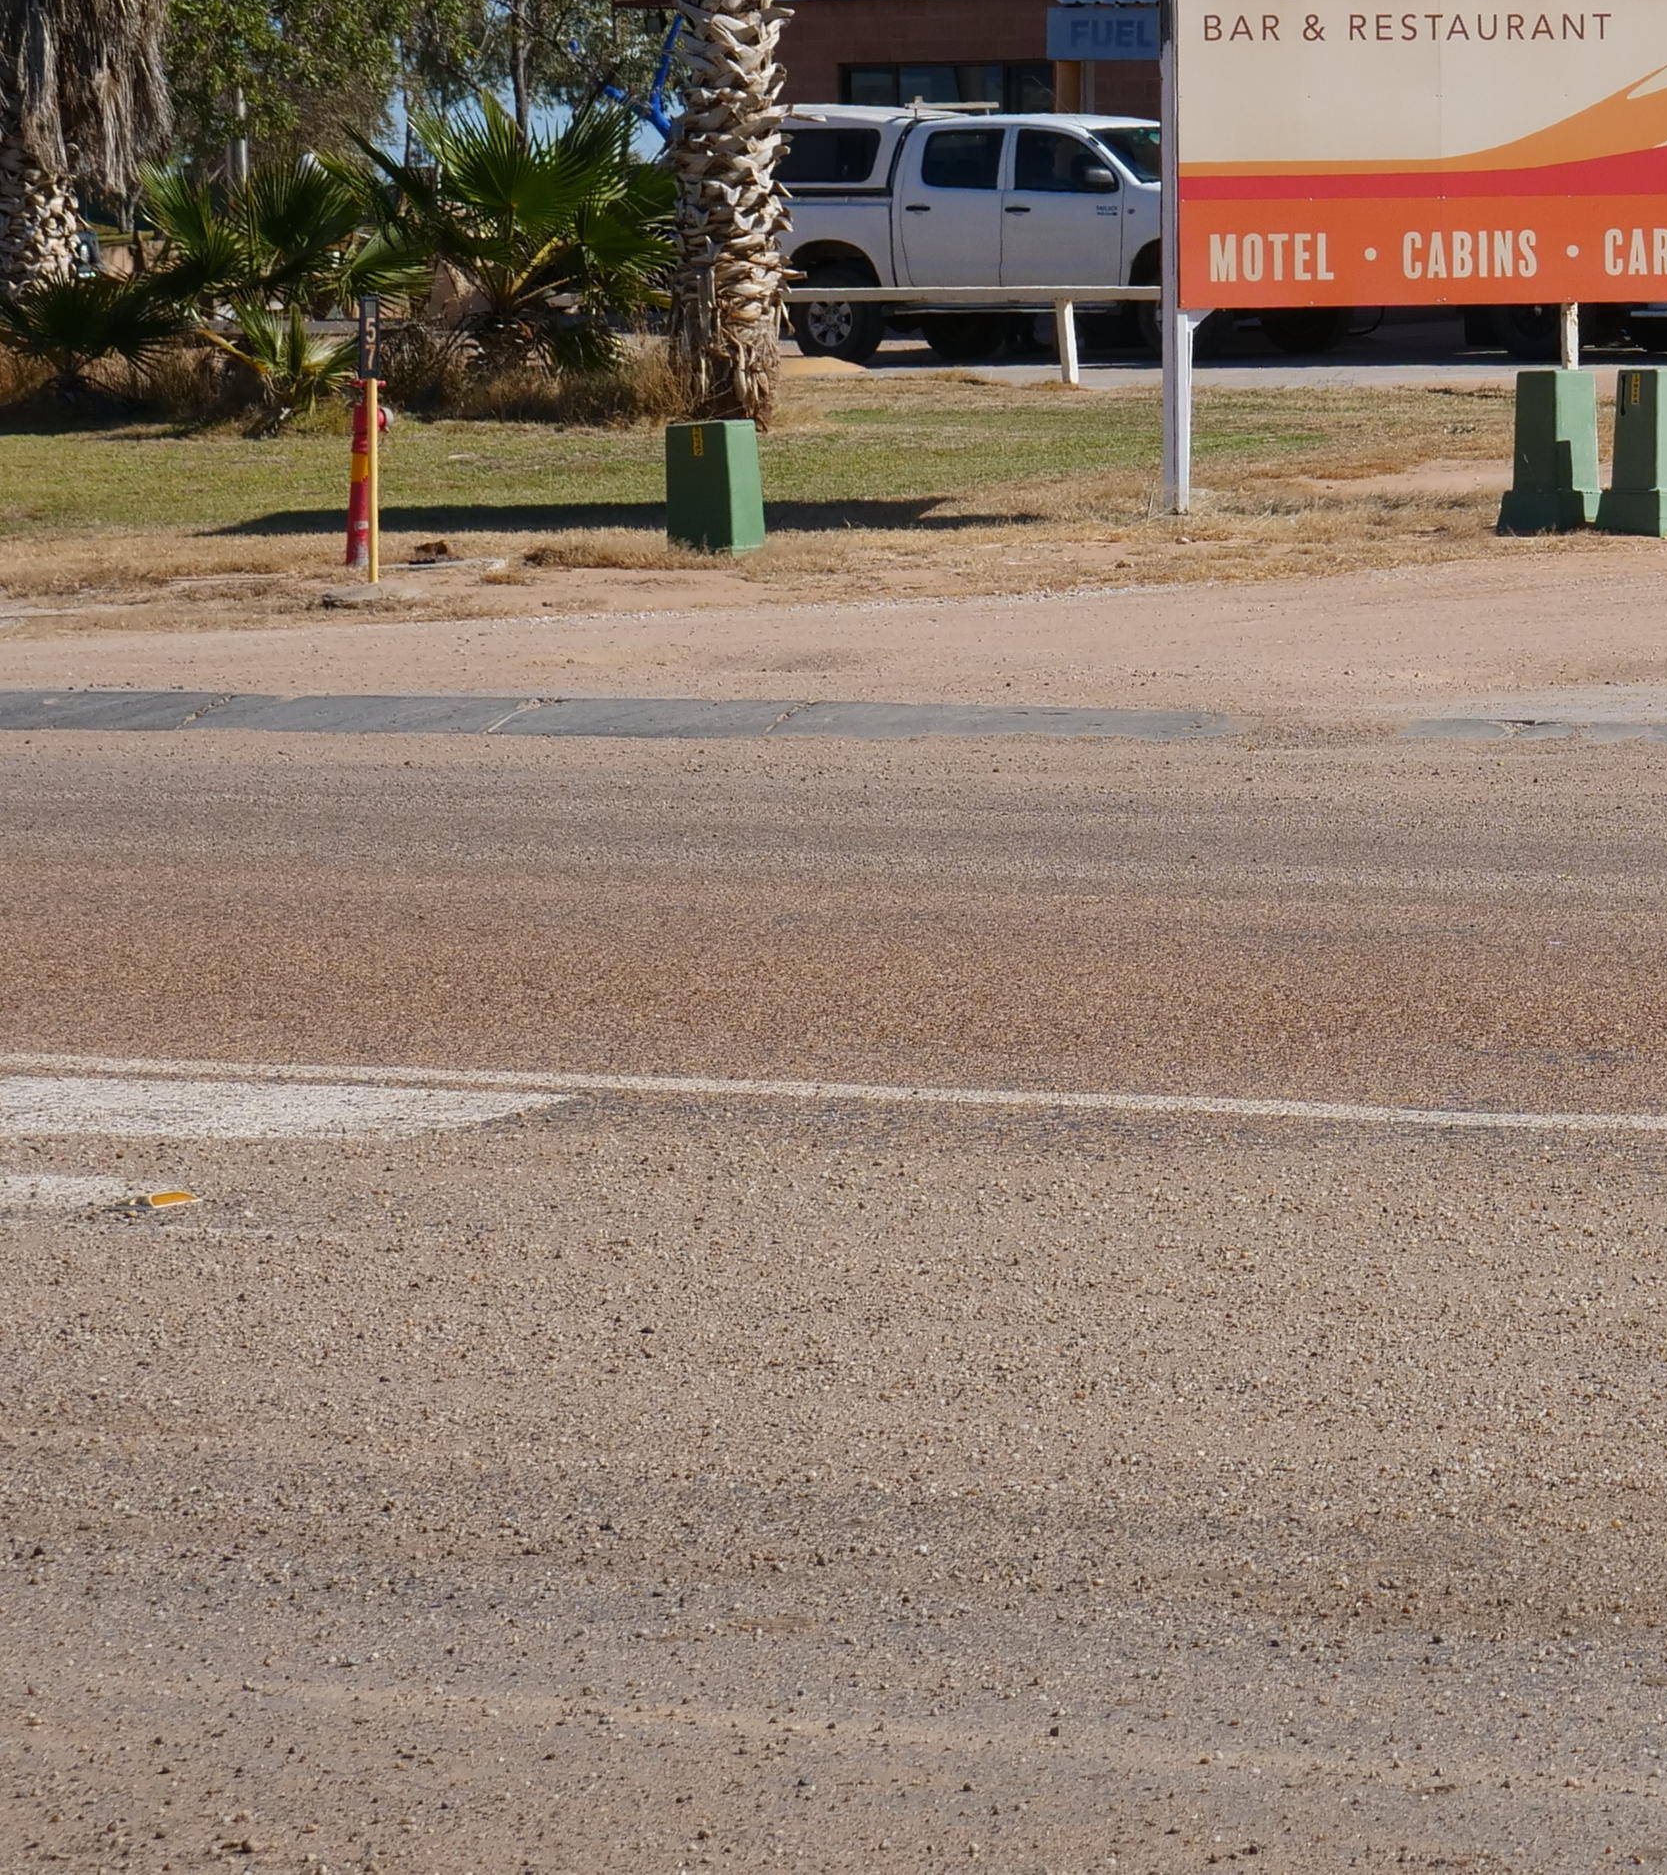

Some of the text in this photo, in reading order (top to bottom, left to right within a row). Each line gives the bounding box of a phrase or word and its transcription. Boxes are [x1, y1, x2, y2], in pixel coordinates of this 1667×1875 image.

[1070, 19, 1153, 48] FUEL
[1204, 13, 1615, 42] BAR & RESTAURANT
[1209, 232, 1335, 283] MOTEL
[1402, 229, 1538, 280] CABINS
